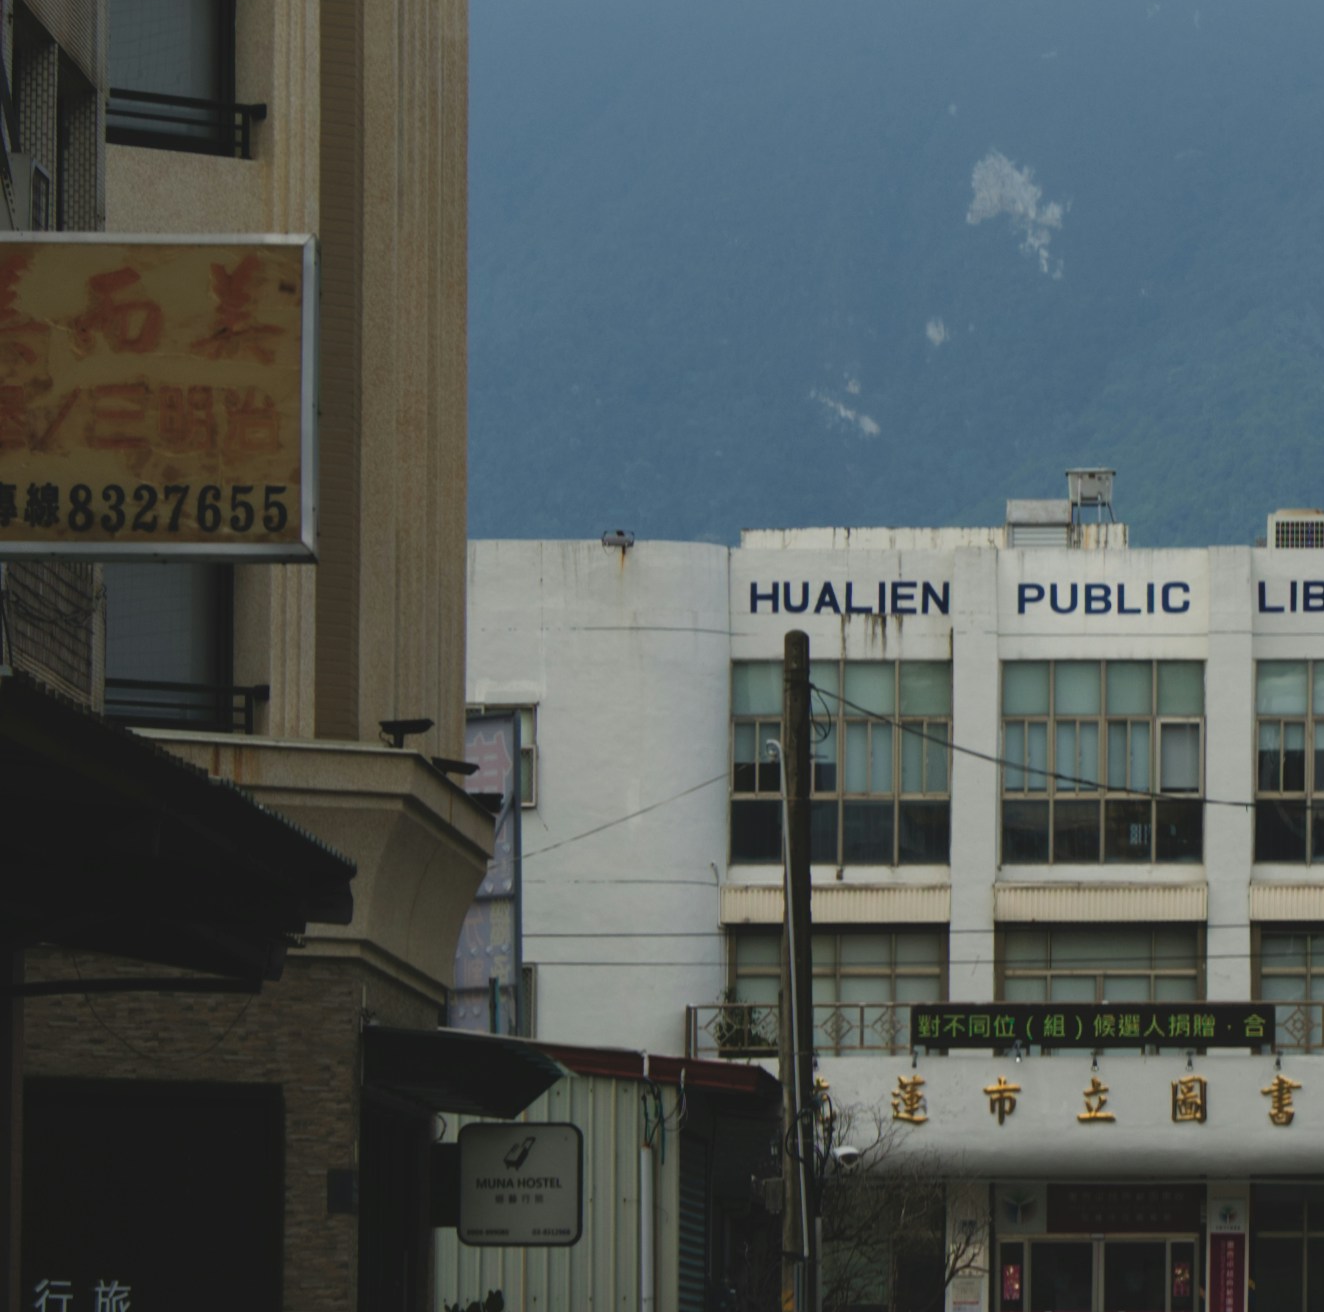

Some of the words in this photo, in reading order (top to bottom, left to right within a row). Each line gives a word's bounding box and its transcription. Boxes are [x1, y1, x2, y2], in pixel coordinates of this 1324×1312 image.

[749, 581, 950, 615] HUALIEN
[1017, 582, 1191, 615] PUBLIC
[476, 1178, 514, 1189] MUNA
[517, 1177, 562, 1189] HOSTEL
